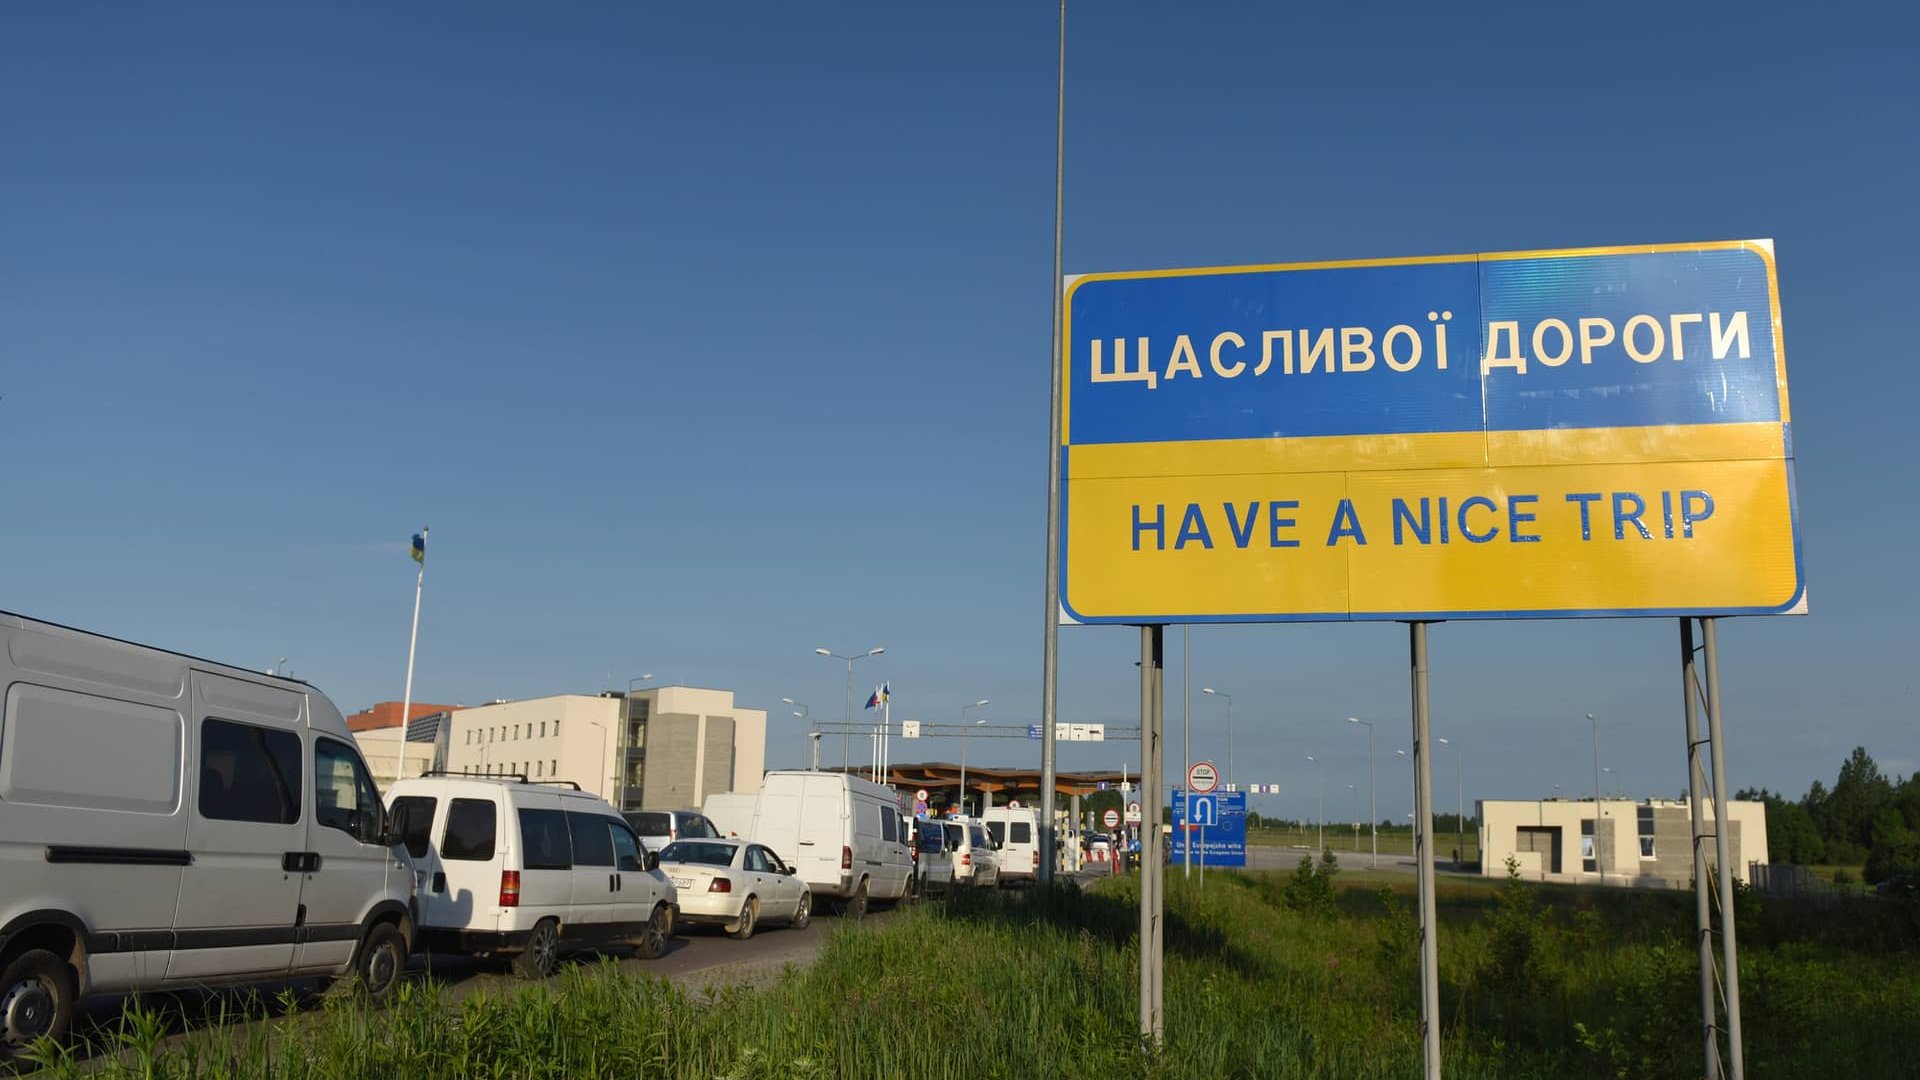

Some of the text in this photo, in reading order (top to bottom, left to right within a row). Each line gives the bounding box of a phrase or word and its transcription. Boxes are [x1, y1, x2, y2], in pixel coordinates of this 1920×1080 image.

[1089, 310, 1752, 390] ЩАСЛИВОЇ ДОРОГИ
[1131, 489, 1716, 552] HAVE A NICE TRIP
[1196, 768, 1210, 776] STOP
